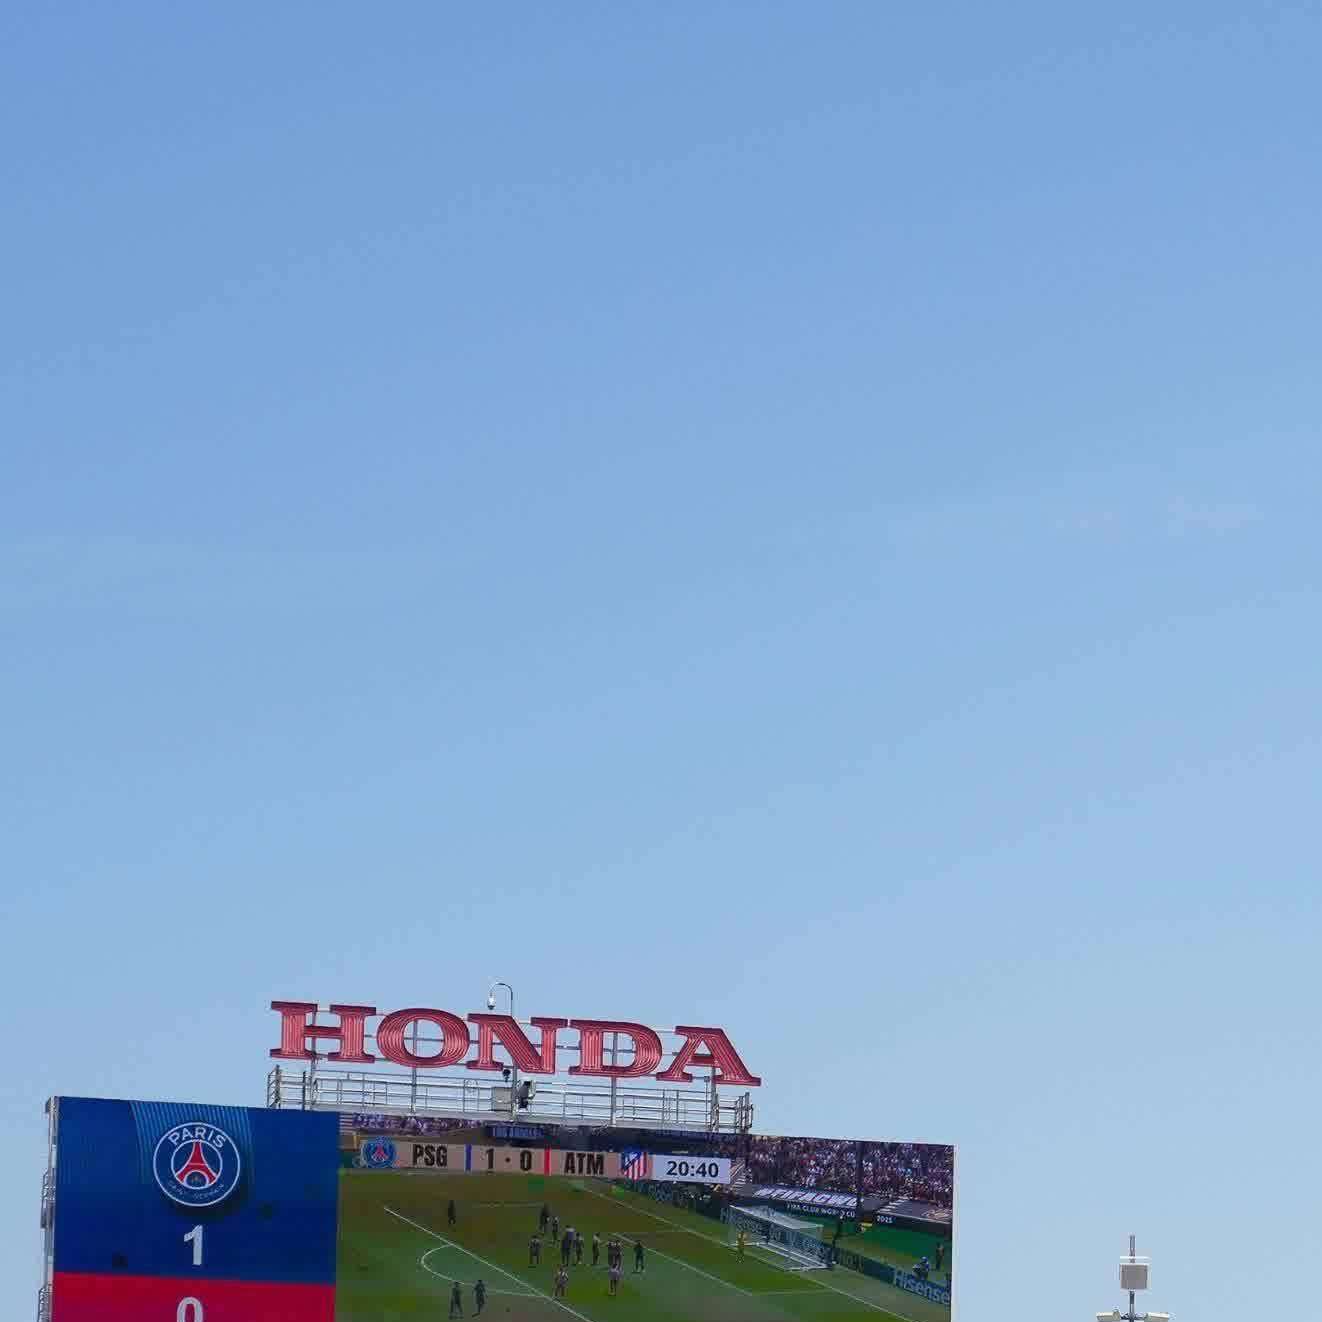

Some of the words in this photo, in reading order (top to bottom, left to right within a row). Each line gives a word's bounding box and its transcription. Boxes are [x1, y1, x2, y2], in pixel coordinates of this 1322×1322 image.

[268, 1001, 762, 1087] HONDA
[167, 1126, 227, 1149] PARIS
[411, 1143, 448, 1168] PSG
[485, 1147, 495, 1171] 1
[519, 1149, 533, 1172] 0
[563, 1152, 605, 1177] ATM
[666, 1160, 720, 1179] 20:40
[183, 1224, 204, 1267] 1
